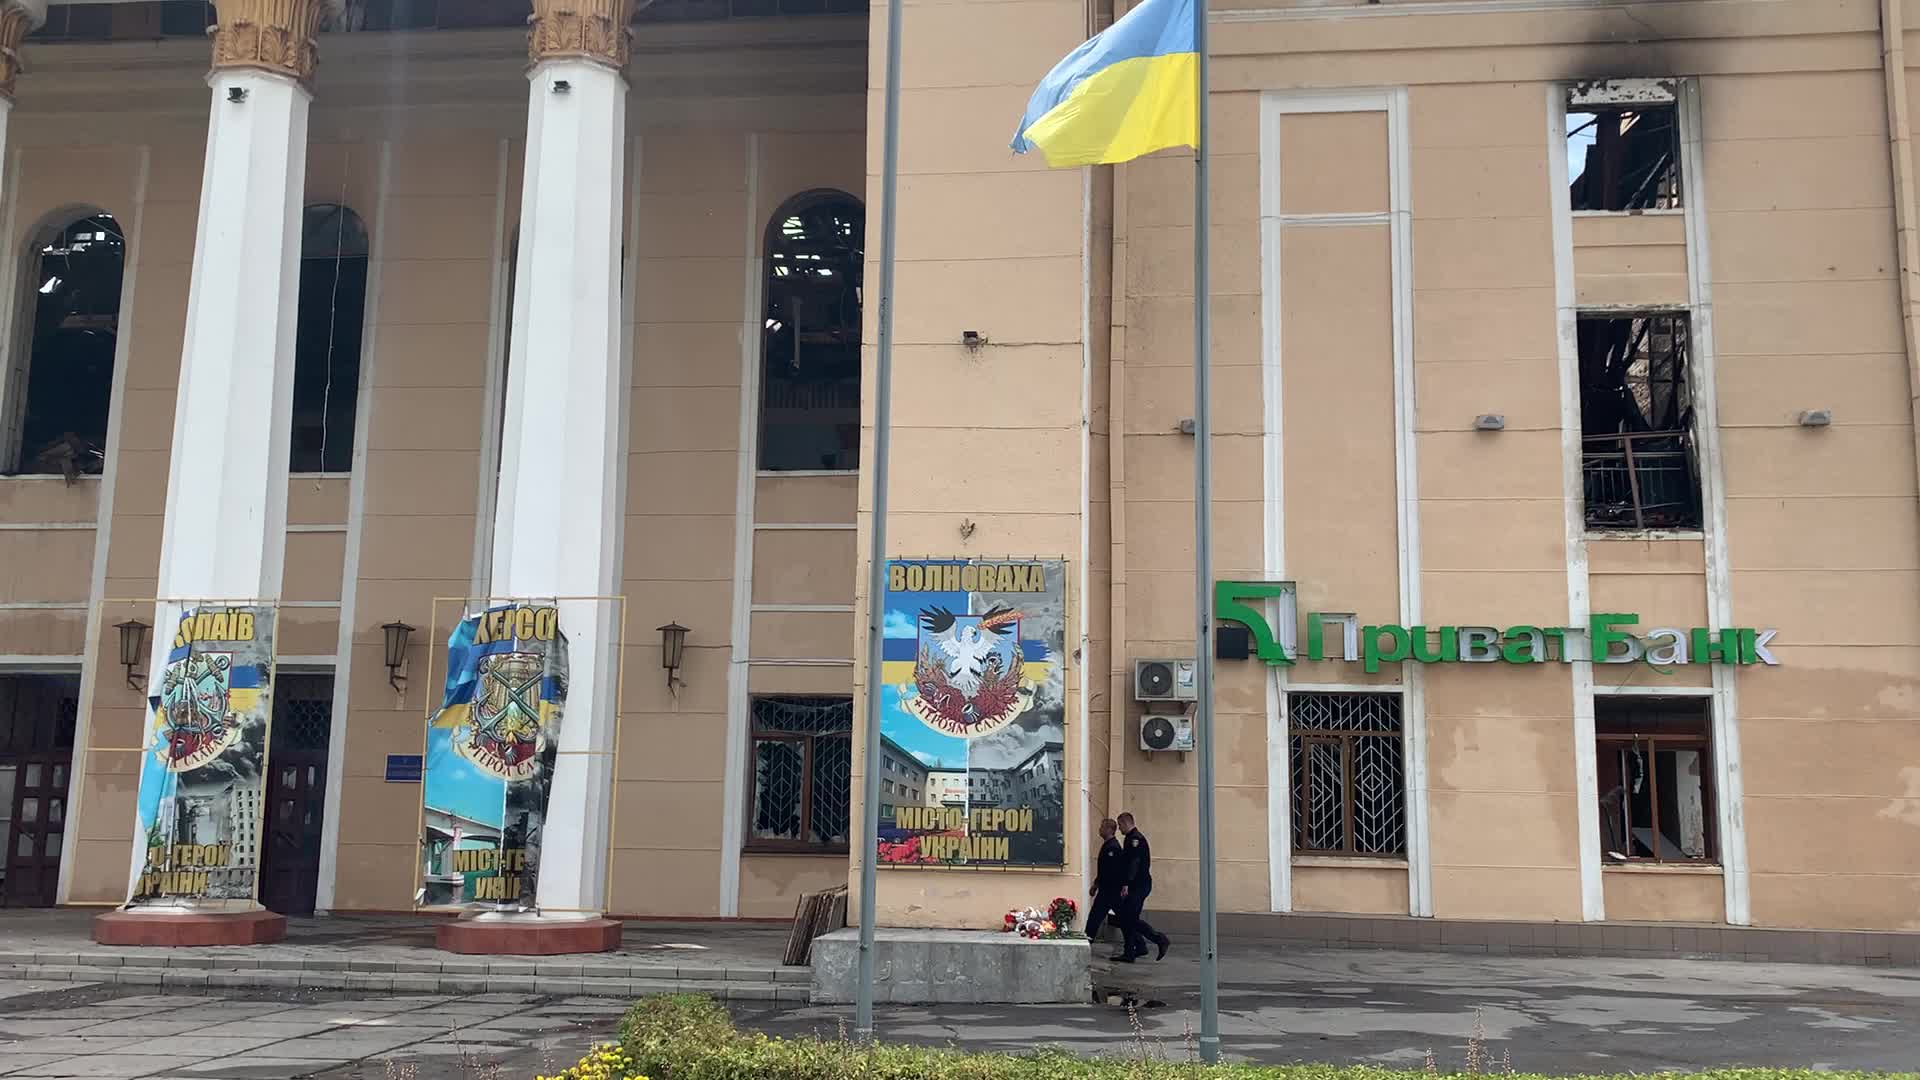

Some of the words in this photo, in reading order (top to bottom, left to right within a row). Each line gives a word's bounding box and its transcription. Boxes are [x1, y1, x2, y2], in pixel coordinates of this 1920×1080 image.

[888, 564, 1046, 592] ВОЛНОВАХА
[918, 704, 969, 735] ГЕРОЯМ
[895, 803, 1034, 832] МІСТО-ГЕРОЙ
[918, 832, 1010, 860] УКРАЇНИ
